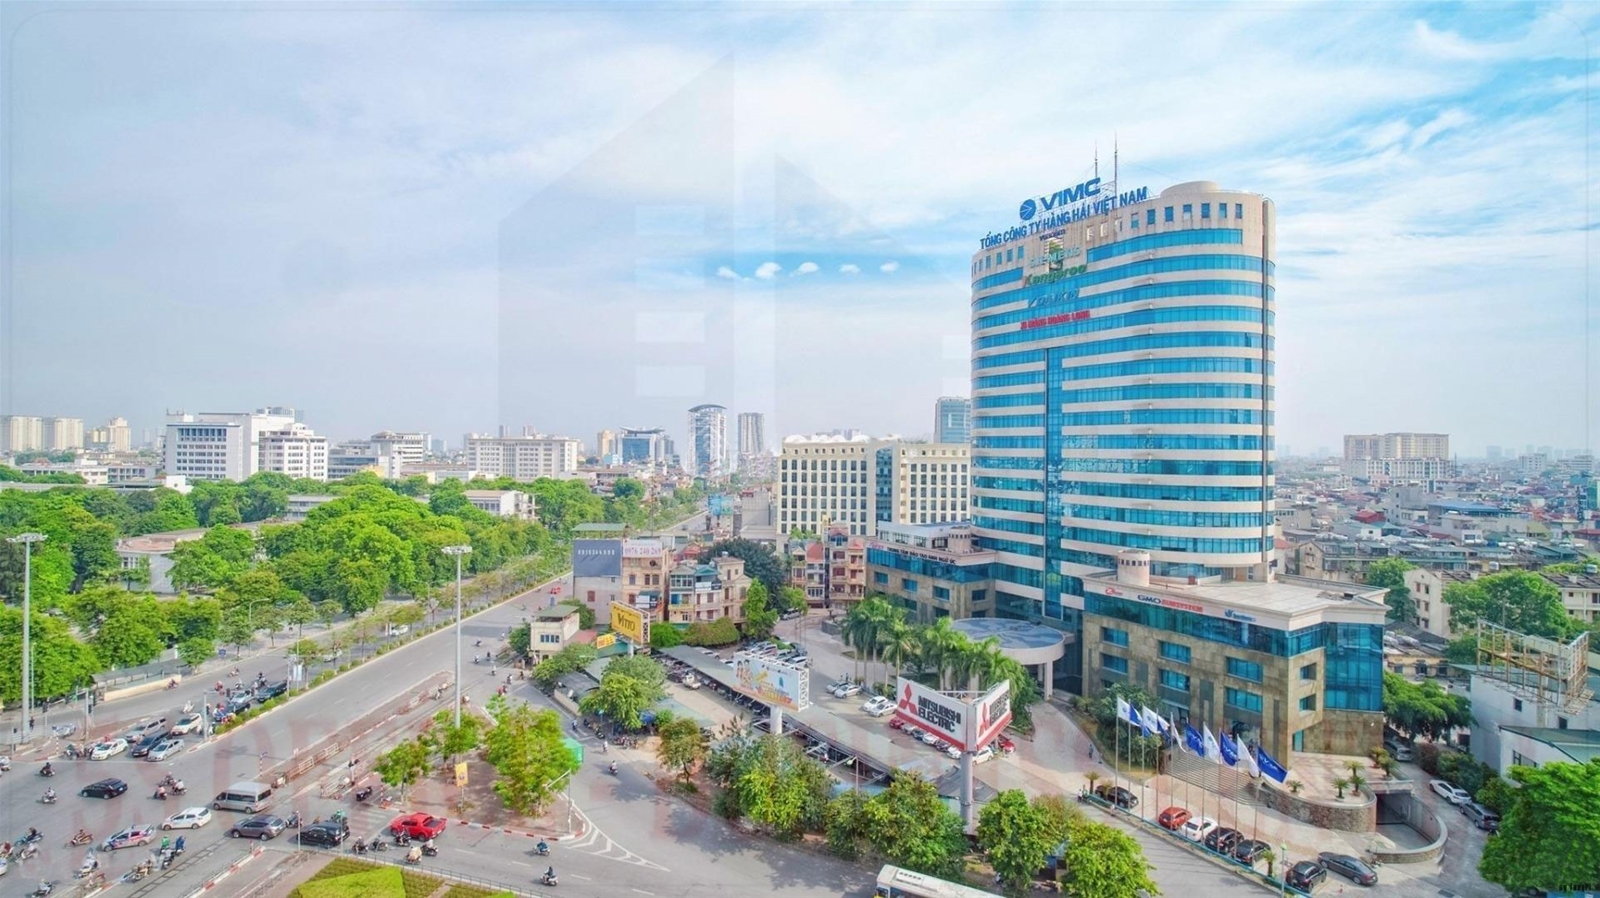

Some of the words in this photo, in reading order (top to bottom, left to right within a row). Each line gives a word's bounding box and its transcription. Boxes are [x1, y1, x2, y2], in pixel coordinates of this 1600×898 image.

[1040, 177, 1101, 211] VIMC
[980, 231, 1002, 249] TỔNG
[1003, 225, 1028, 242] CÔNG
[1029, 220, 1042, 234] TY
[1043, 212, 1071, 230] HÀNG
[1072, 205, 1091, 221] HẢI
[1093, 195, 1117, 216] VIỆT
[1119, 186, 1148, 206] NAM
[918, 695, 961, 725] MITSUBISHI
[918, 706, 955, 733] ELECTRIC
